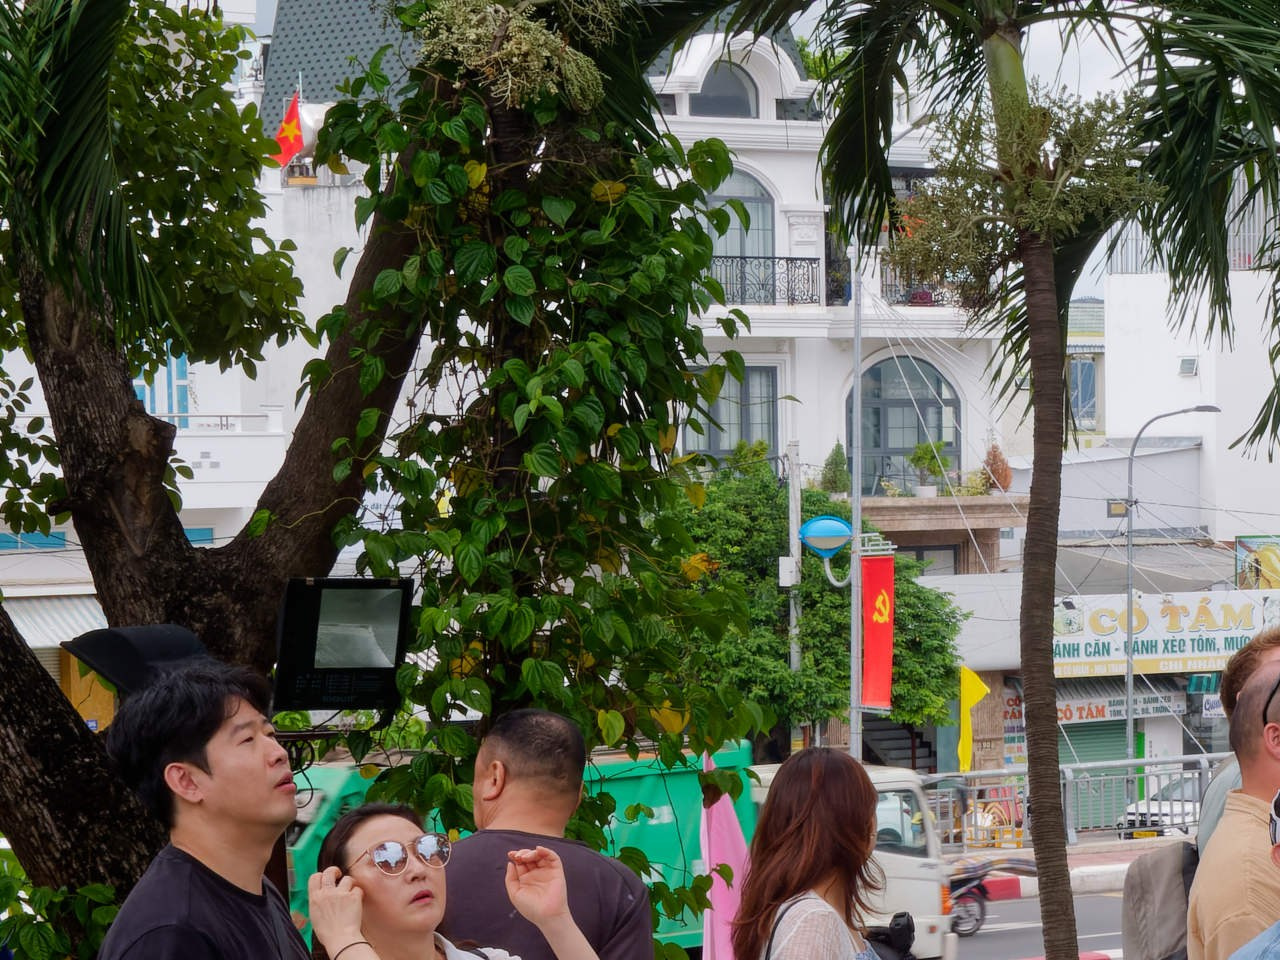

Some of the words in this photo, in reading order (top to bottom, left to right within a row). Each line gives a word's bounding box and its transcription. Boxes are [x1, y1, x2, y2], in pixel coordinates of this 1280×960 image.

[1088, 598, 1149, 636] CÔ
[1161, 596, 1256, 632] TÁM
[1053, 640, 1080, 658] ÁNH
[1056, 704, 1074, 721] CÔ
[1076, 702, 1106, 720] TÁM
